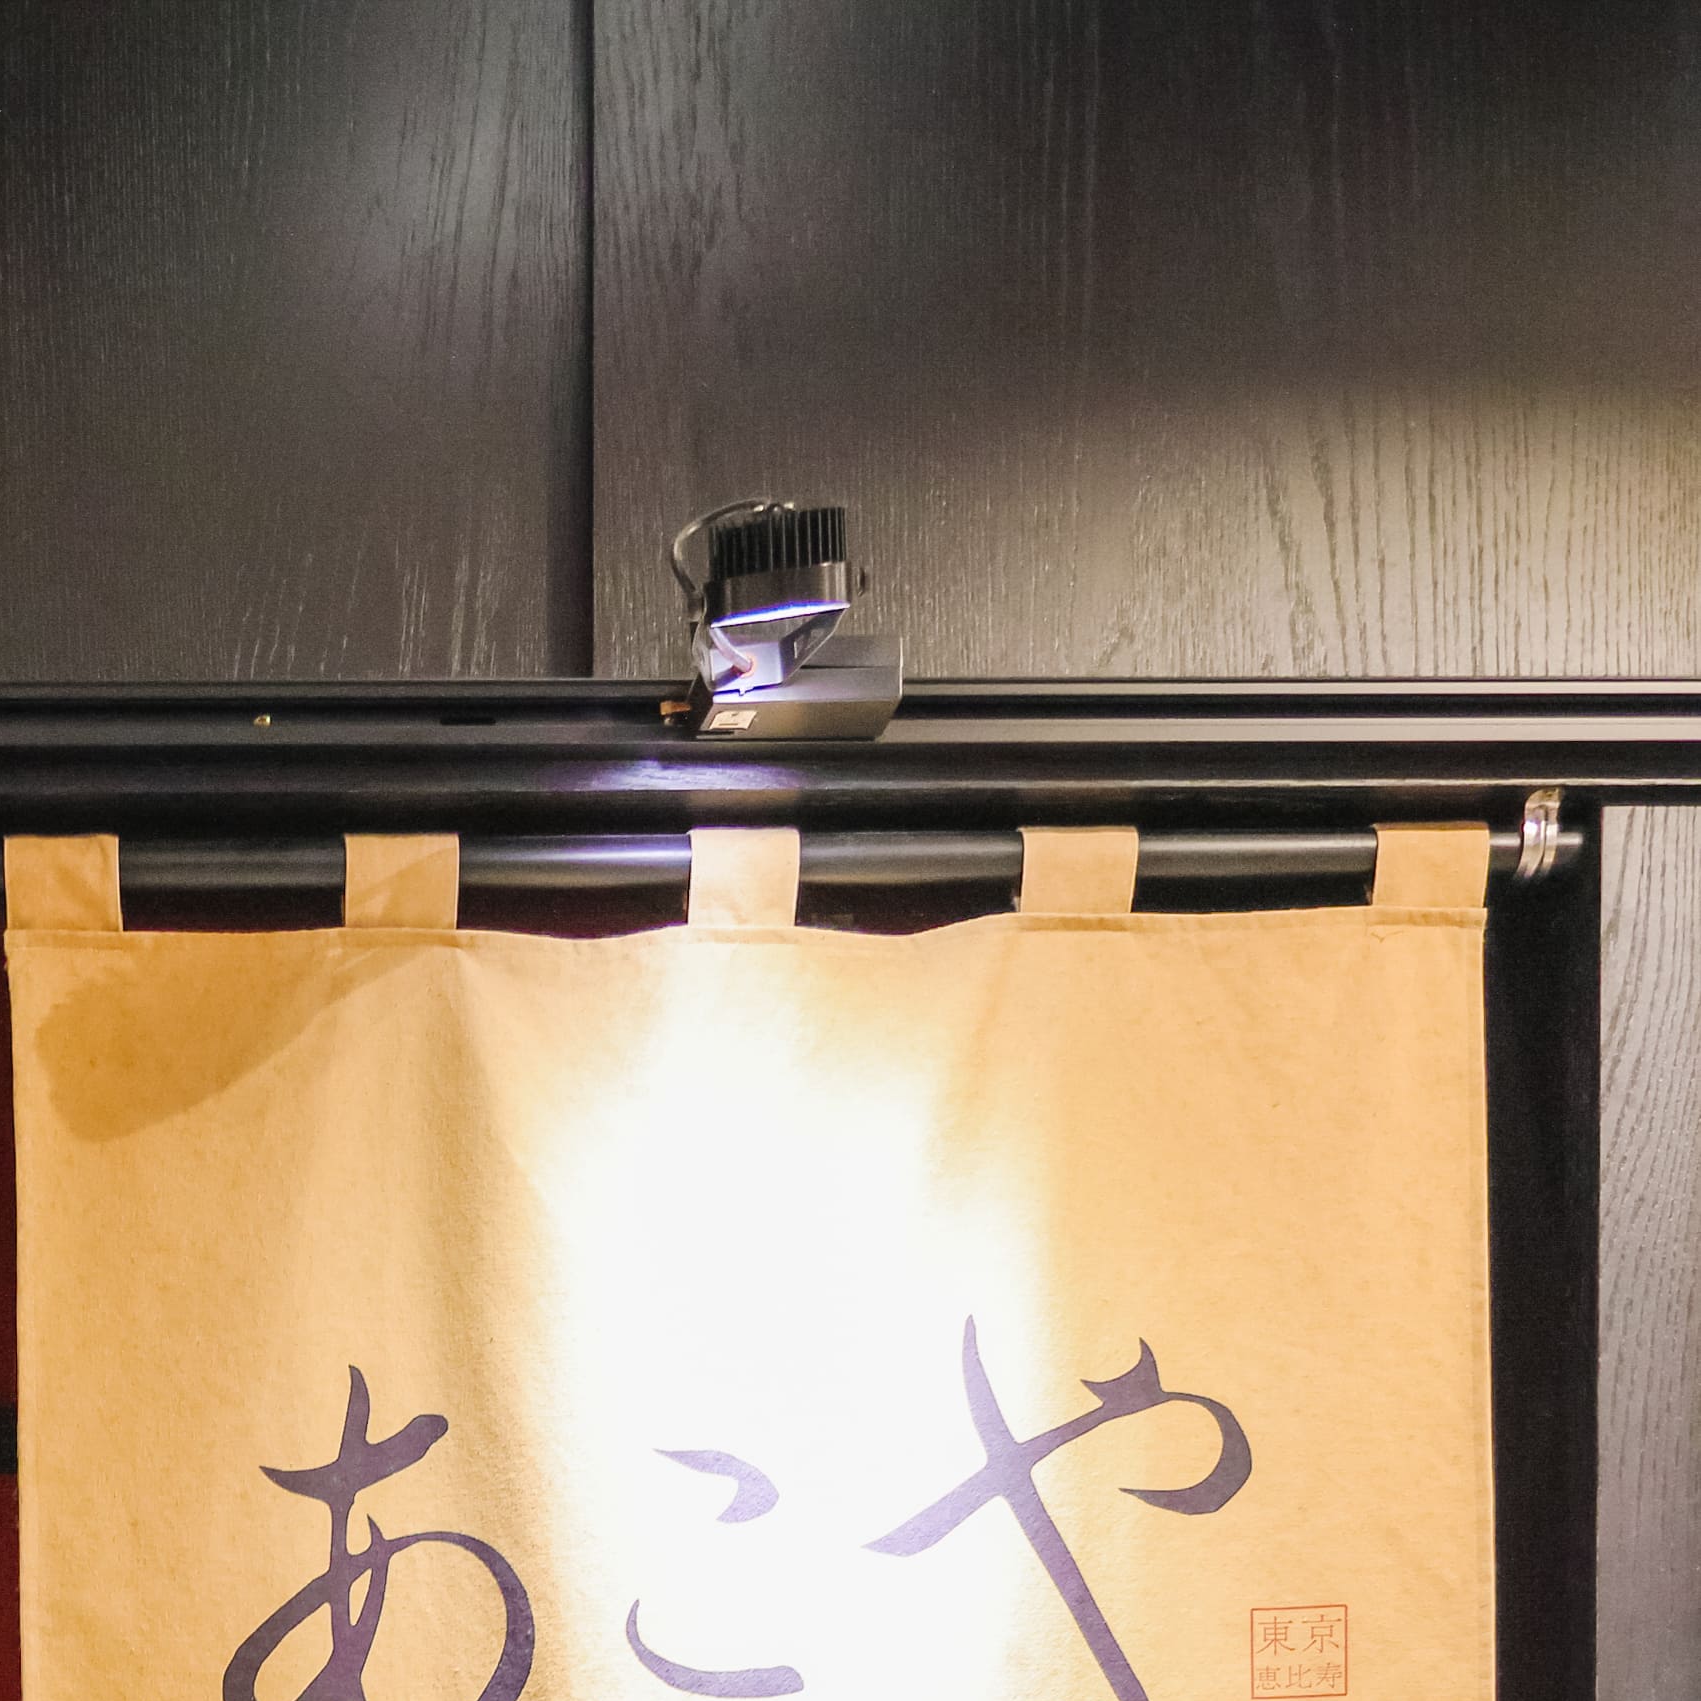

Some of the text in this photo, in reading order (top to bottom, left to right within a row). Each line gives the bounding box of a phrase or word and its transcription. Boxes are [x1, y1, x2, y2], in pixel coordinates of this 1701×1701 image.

[1256, 1614, 1342, 1656] 東京
[1255, 1662, 1343, 1691] 恵比寿
